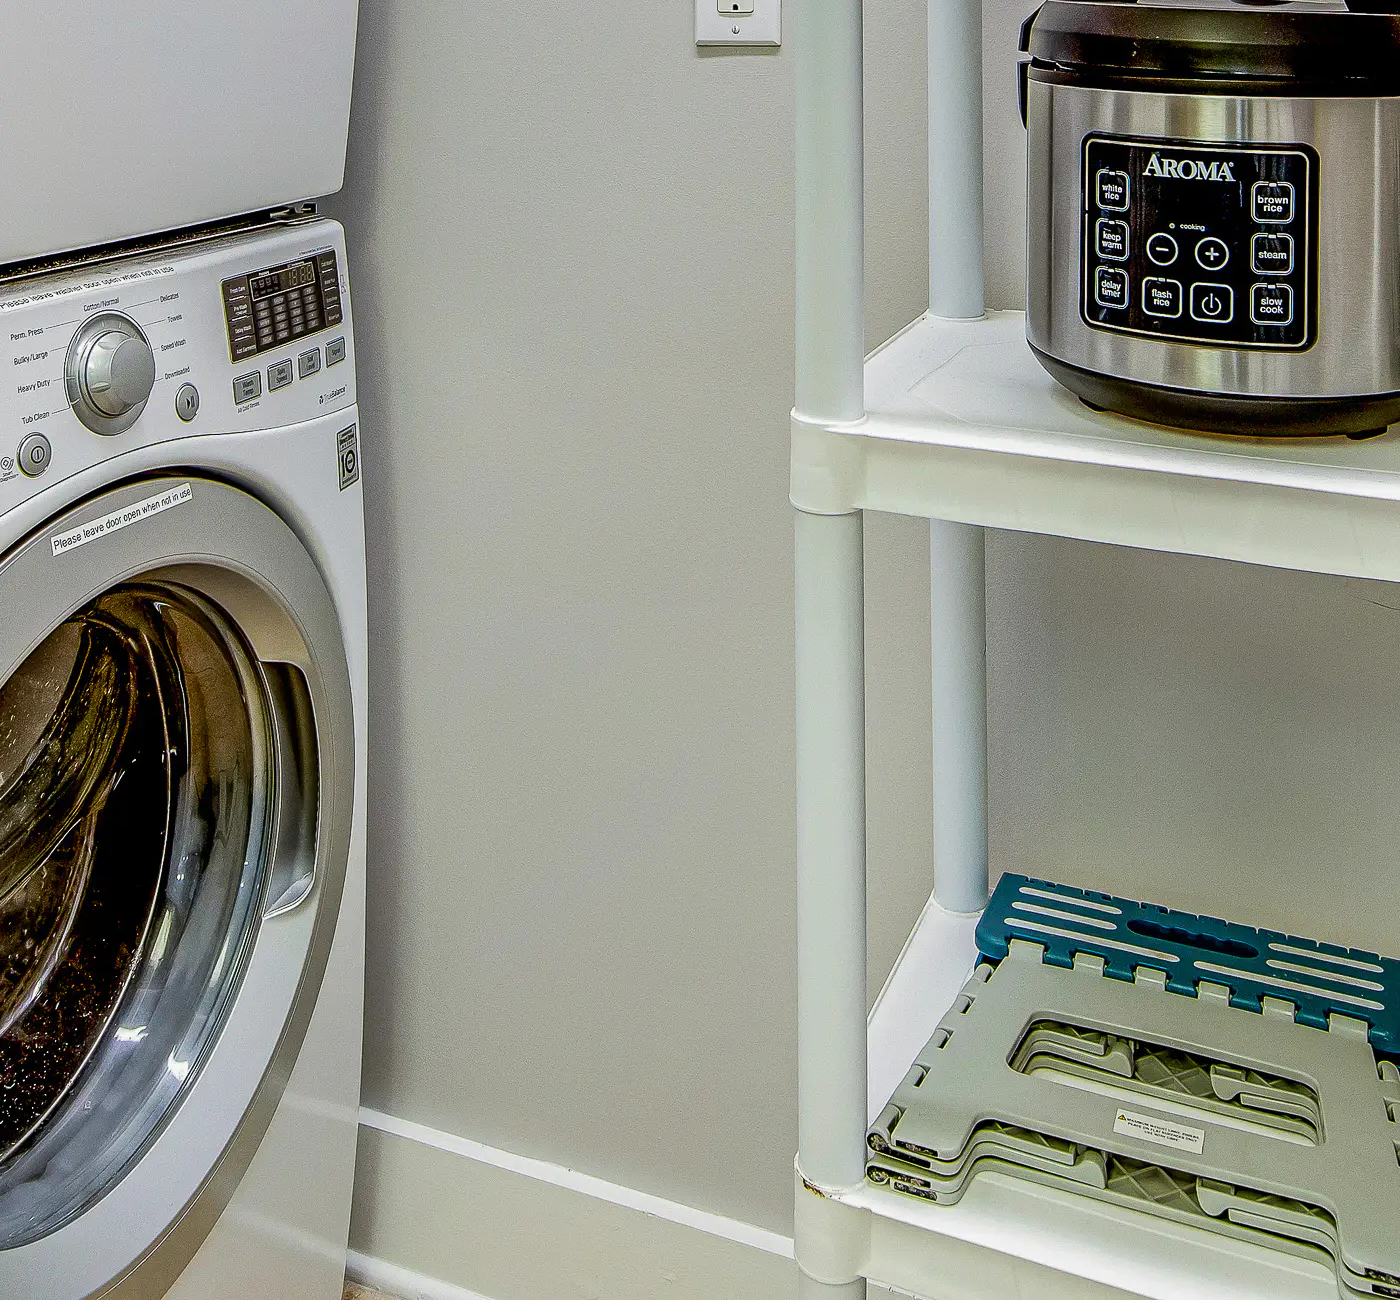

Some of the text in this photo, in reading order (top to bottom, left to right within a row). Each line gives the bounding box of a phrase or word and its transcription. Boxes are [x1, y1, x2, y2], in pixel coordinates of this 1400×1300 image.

[1142, 153, 1236, 182] AROMA
[1102, 184, 1123, 194] white
[1104, 192, 1120, 201] rice
[1257, 195, 1289, 205] brown
[1263, 203, 1283, 213] rice
[1179, 223, 1206, 232] cooking
[1102, 231, 1121, 243] keep
[1102, 240, 1123, 250] warm
[1258, 251, 1287, 260] steam
[30, 292, 54, 302] leave
[162, 265, 175, 275] use
[1101, 280, 1122, 292] delay
[1102, 288, 1121, 298] timer
[1151, 288, 1172, 300] flash
[83, 297, 120, 312] Cotton/Normal
[1153, 297, 1170, 308] rice
[1260, 297, 1283, 306] slow
[1260, 305, 1284, 315] cook
[10, 327, 44, 342] Perm. Press
[13, 350, 49, 366] Bulky/Large
[17, 379, 51, 394] Heavy Duty
[22, 411, 50, 425] Tub Clean
[53, 487, 192, 551] Please leave door open when not in use
